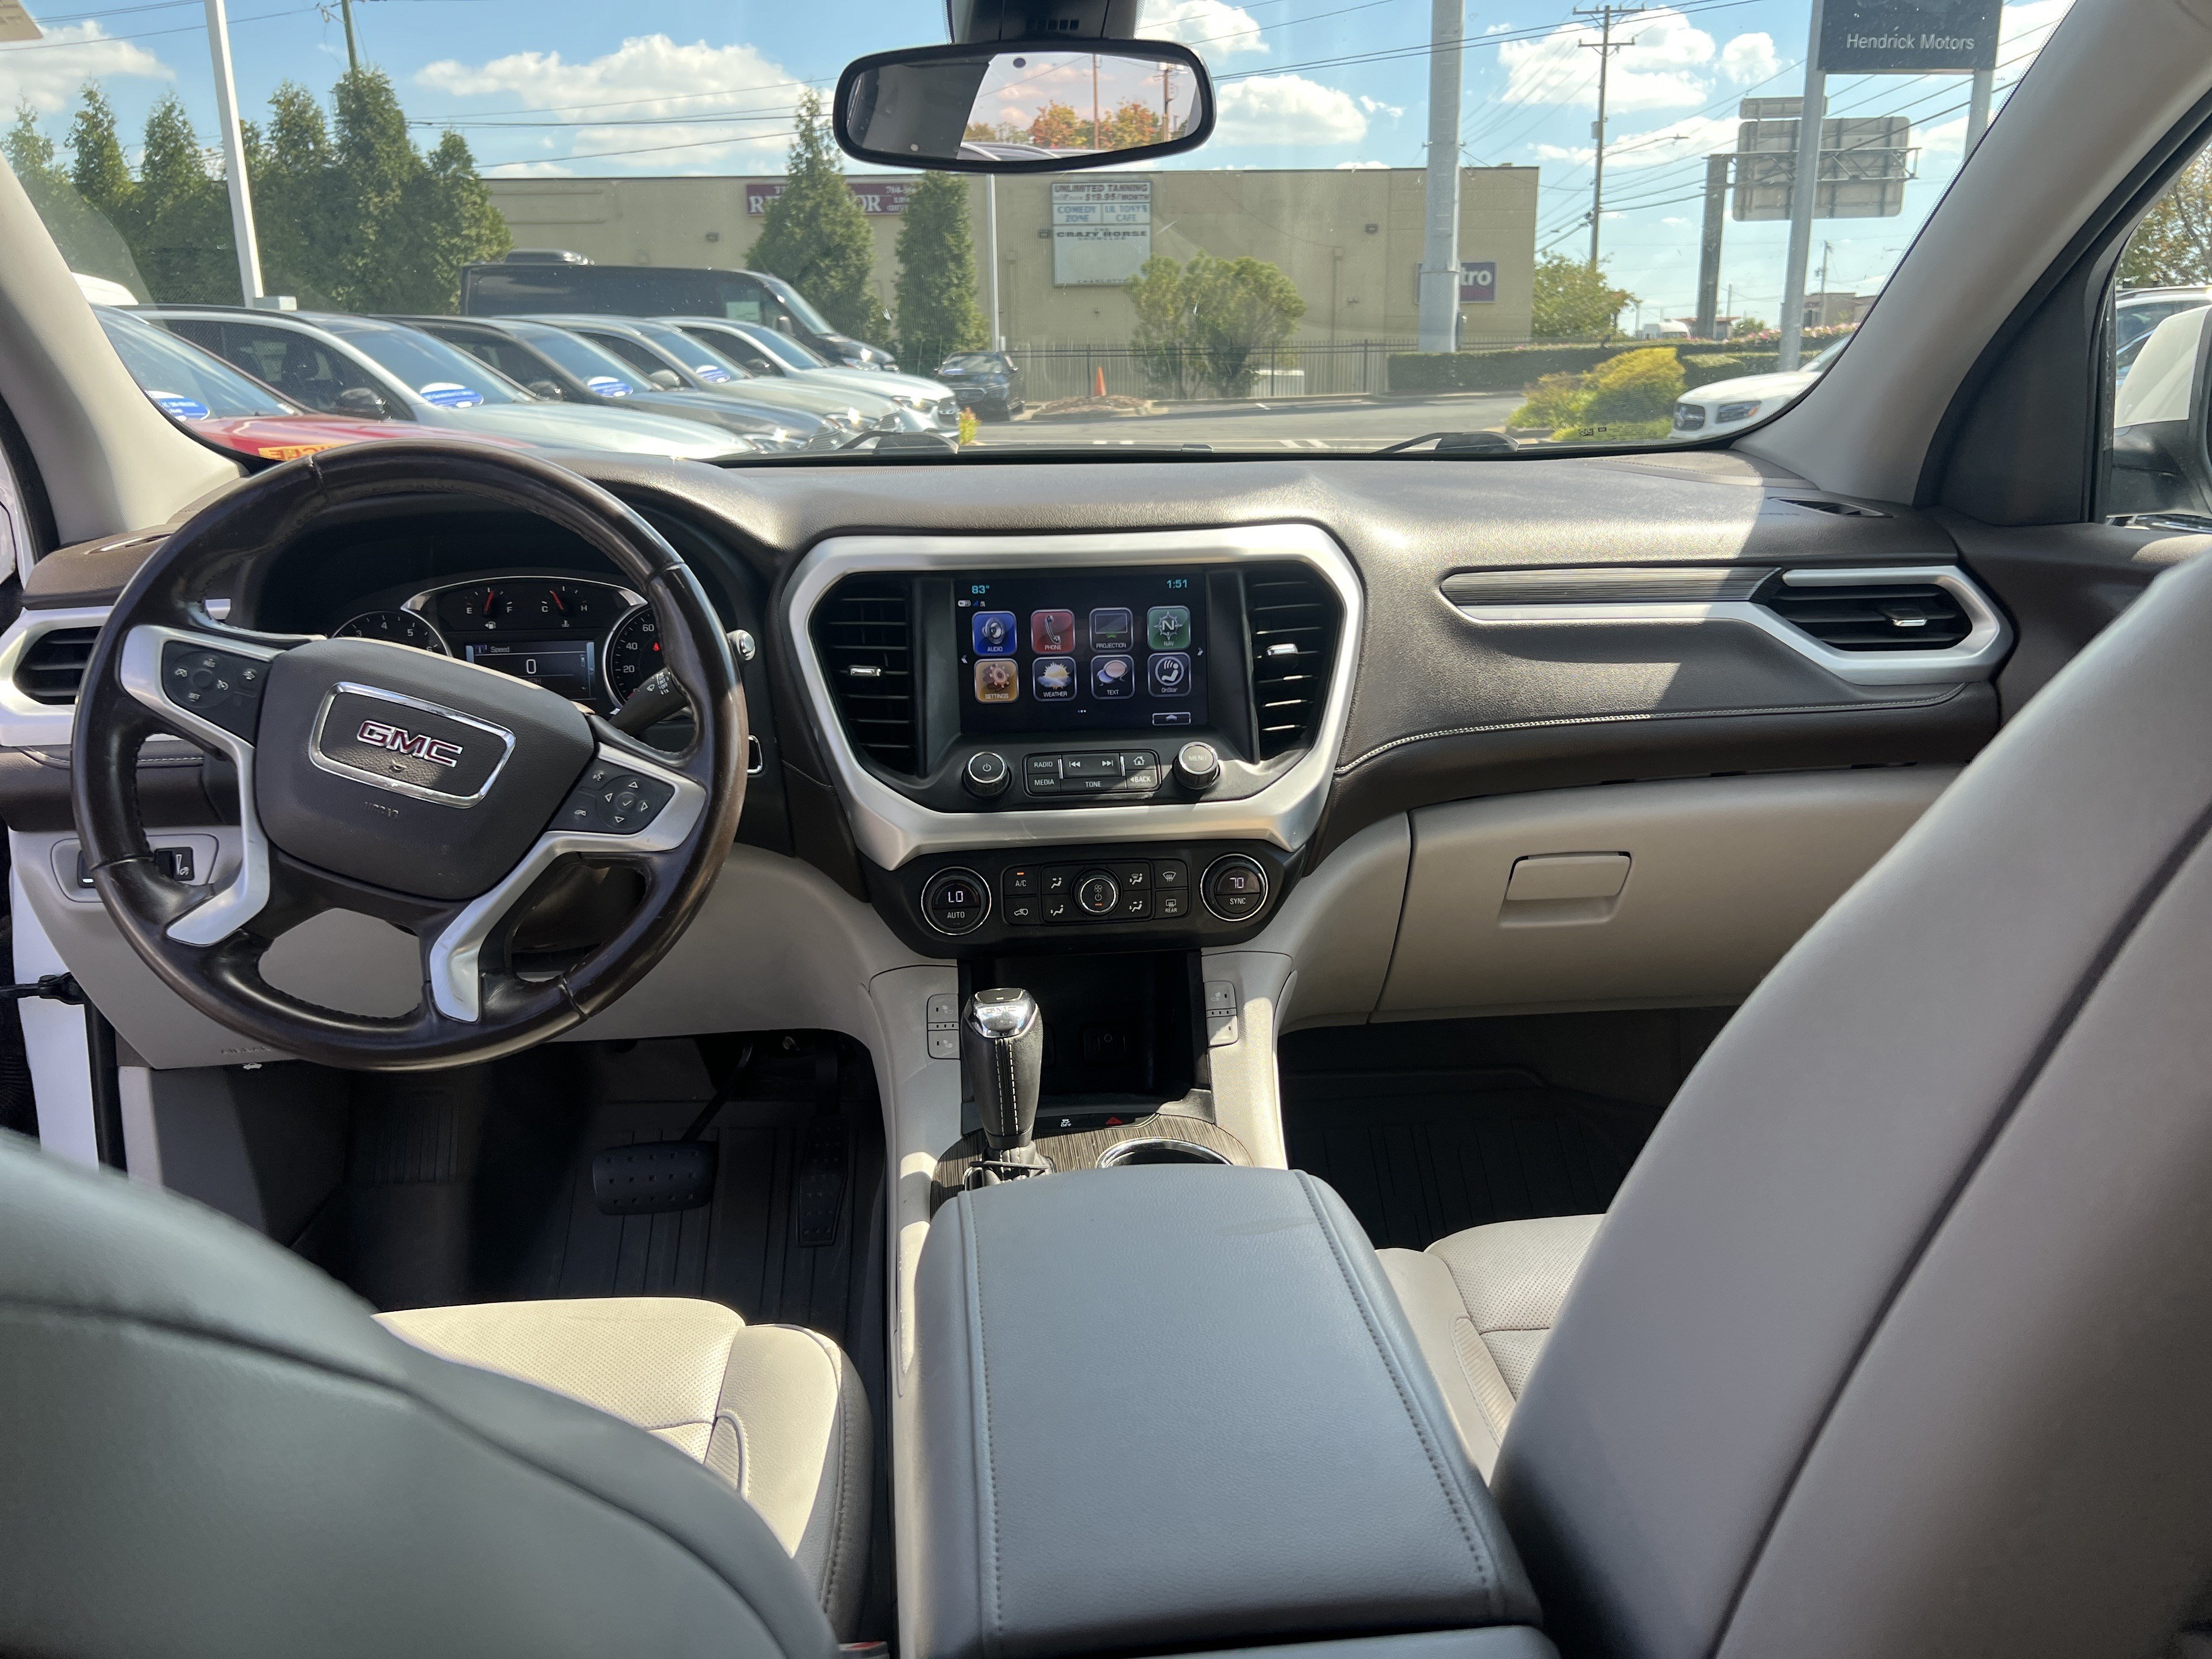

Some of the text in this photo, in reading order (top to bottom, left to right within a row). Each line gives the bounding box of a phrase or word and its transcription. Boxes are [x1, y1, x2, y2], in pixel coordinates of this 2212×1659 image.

[1847, 33, 1975, 50] Hendrick Motors
[1167, 579, 1188, 589] 1:51
[526, 659, 537, 674] 0
[357, 720, 463, 768] GMC
[1135, 775, 1151, 783] BACK
[1015, 879, 1026, 888] A/C
[1230, 877, 1244, 889] 70
[949, 891, 963, 902] LO
[1229, 897, 1246, 905] SYNC
[947, 911, 965, 919] AUTO
